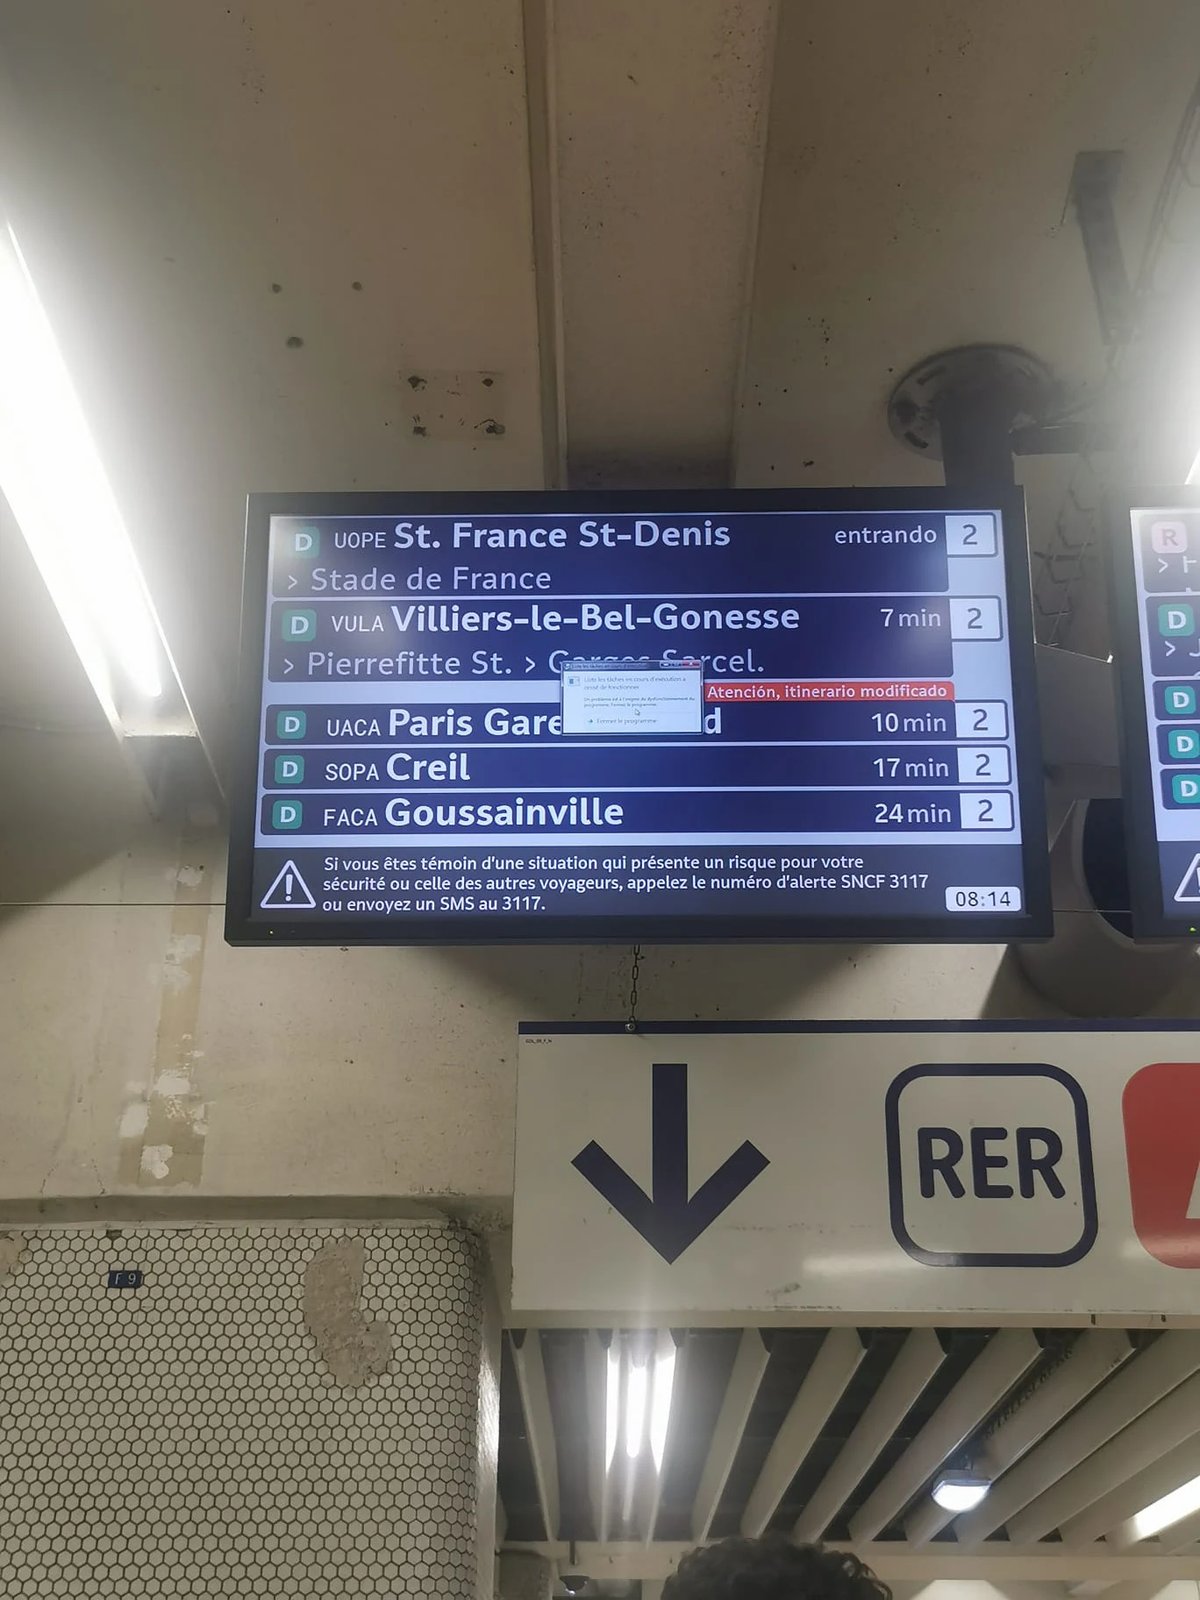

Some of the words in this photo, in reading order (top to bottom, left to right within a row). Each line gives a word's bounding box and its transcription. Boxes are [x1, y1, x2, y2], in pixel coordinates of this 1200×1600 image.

[294, 532, 313, 553] D
[334, 532, 386, 549] UOPE
[394, 522, 441, 549] St.
[453, 522, 567, 549] France
[579, 520, 731, 548] St-Denis
[834, 525, 937, 544] entrando
[961, 524, 978, 545] 2
[1162, 529, 1178, 546] R
[311, 567, 396, 591] Stade
[406, 567, 442, 591] de
[453, 566, 552, 590] France
[291, 615, 309, 635] D
[331, 615, 384, 632] VULA
[391, 603, 800, 632] Villiers-le-Bel-Gonesse
[880, 608, 895, 628] 7
[899, 608, 941, 627] min
[967, 608, 983, 629] 2
[1168, 611, 1187, 629] D
[308, 651, 460, 675] Pierrefitte
[472, 651, 512, 675] St.
[707, 684, 781, 700] Atención,
[785, 684, 855, 698] itinerario
[860, 684, 947, 698] modificado
[1173, 692, 1190, 708] D
[284, 716, 301, 733] D
[327, 719, 381, 737] UACA
[389, 708, 473, 736] Paris
[484, 708, 563, 736] Gare
[871, 712, 899, 732] 10
[903, 712, 947, 732] min
[973, 709, 989, 731] 2
[1177, 736, 1194, 752] D
[282, 761, 299, 778] D
[325, 764, 379, 781] SOPA
[386, 752, 471, 782] Creil
[873, 757, 900, 778] 17
[905, 757, 949, 777] min
[975, 754, 991, 776] 2
[1181, 780, 1198, 797] D
[280, 806, 296, 823] D
[323, 808, 378, 826] FACA
[385, 797, 624, 827] Goussainville
[875, 803, 904, 823] 24
[907, 803, 952, 823] min
[978, 799, 994, 822] 2
[324, 857, 340, 871] Si
[342, 859, 379, 871] vous
[383, 856, 417, 871] êtes
[421, 856, 477, 871] témoin
[482, 856, 524, 870] d'une
[529, 855, 598, 870] situation
[602, 855, 627, 873] qui
[631, 855, 700, 873] présente
[704, 858, 724, 869] un
[728, 855, 776, 873] risque
[781, 857, 817, 872] pour
[821, 856, 864, 869] votre
[323, 876, 386, 891] sécurité
[390, 879, 410, 891] ou
[414, 875, 451, 890] celle
[455, 875, 482, 890] des
[486, 876, 535, 890] autres
[539, 878, 623, 894] voyageurs,
[627, 875, 688, 892] appelez
[692, 874, 706, 889] le
[711, 874, 772, 889] numéro
[777, 874, 836, 888] d'alerte
[841, 874, 885, 888] SNCF
[889, 874, 929, 888] 3117
[322, 899, 342, 911] ou
[347, 898, 411, 915] envoyez
[415, 898, 435, 910] un
[440, 896, 475, 910] SMS
[479, 898, 498, 910] au
[502, 896, 546, 910] 3117.
[955, 891, 1011, 908] 08:14
[917, 1126, 1066, 1199] RER
